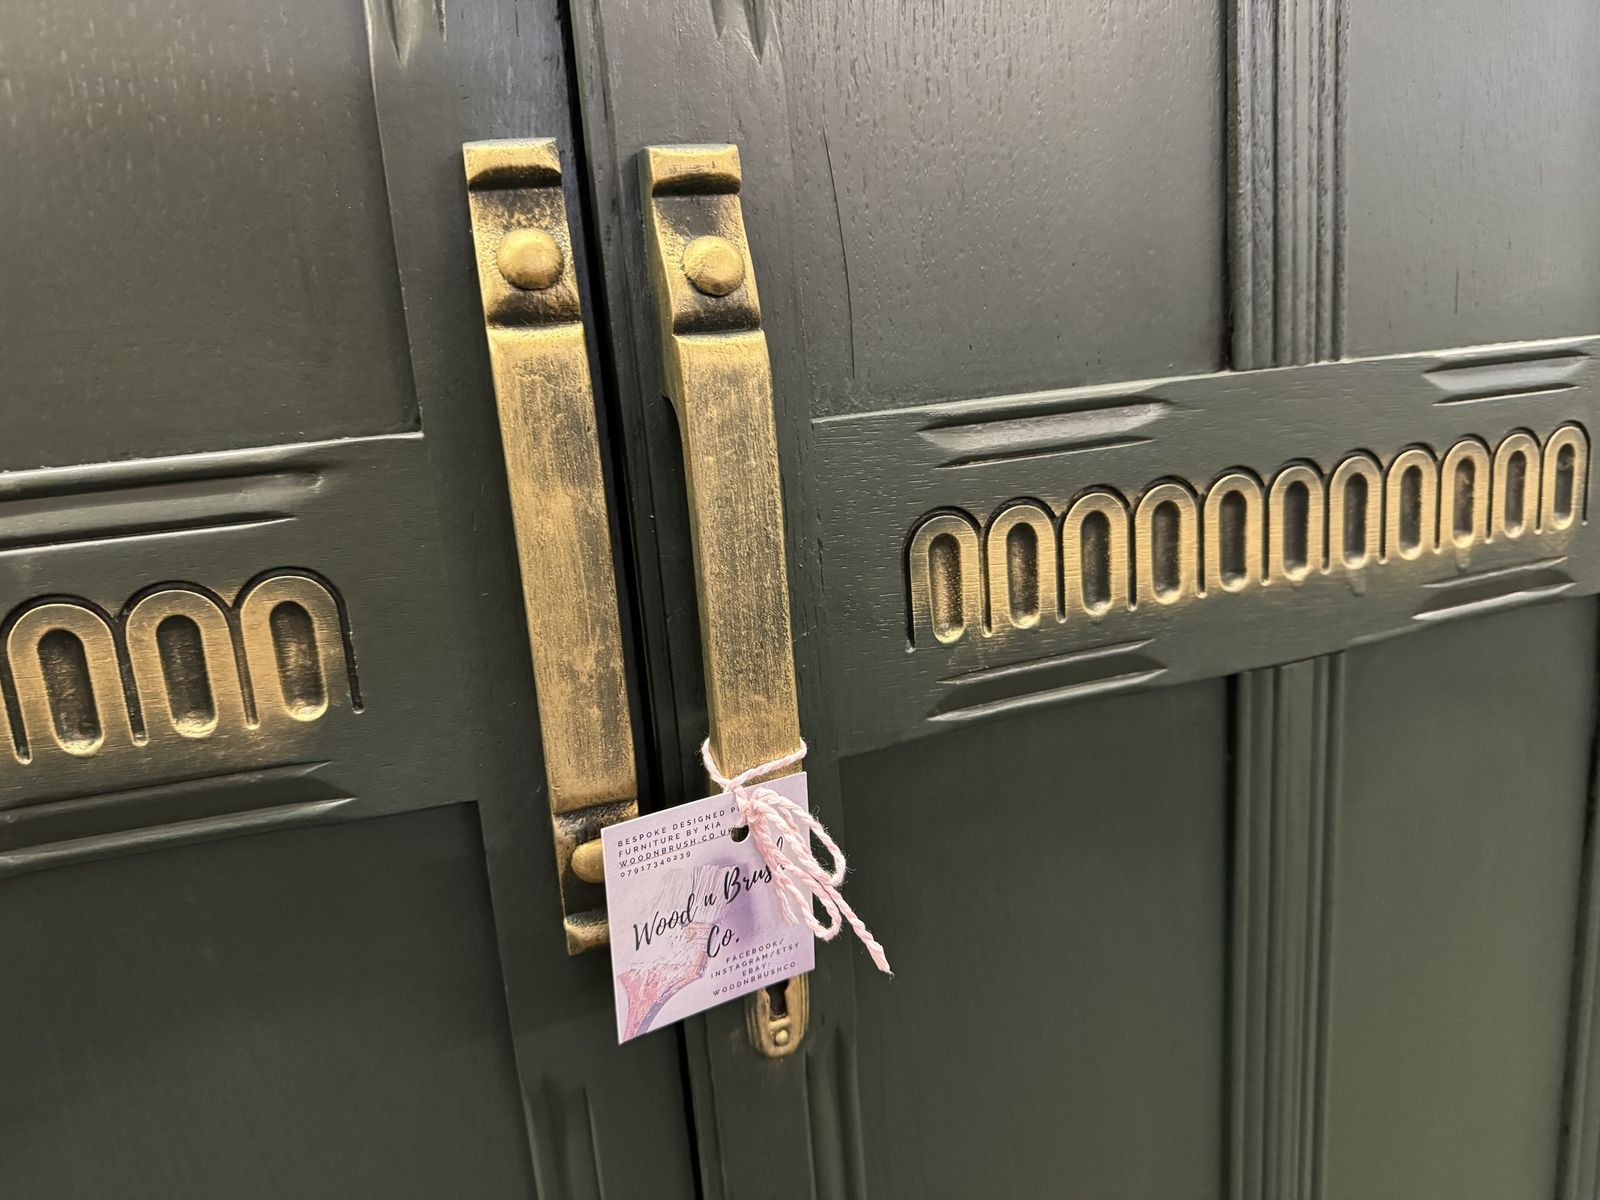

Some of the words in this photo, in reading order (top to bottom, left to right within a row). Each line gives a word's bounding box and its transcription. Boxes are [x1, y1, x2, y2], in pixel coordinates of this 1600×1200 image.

[617, 826, 668, 848] BESPOKE
[672, 810, 725, 831] DESIGNED
[618, 832, 681, 858] FURNITURE
[686, 827, 699, 837] BY
[704, 821, 722, 831] KIA
[620, 851, 692, 878] 07917340239
[633, 893, 698, 951] Wood
[706, 924, 740, 958] Co.
[726, 938, 784, 964] FACEBOOK/
[710, 942, 800, 979] INSTAGRAM/ETSY
